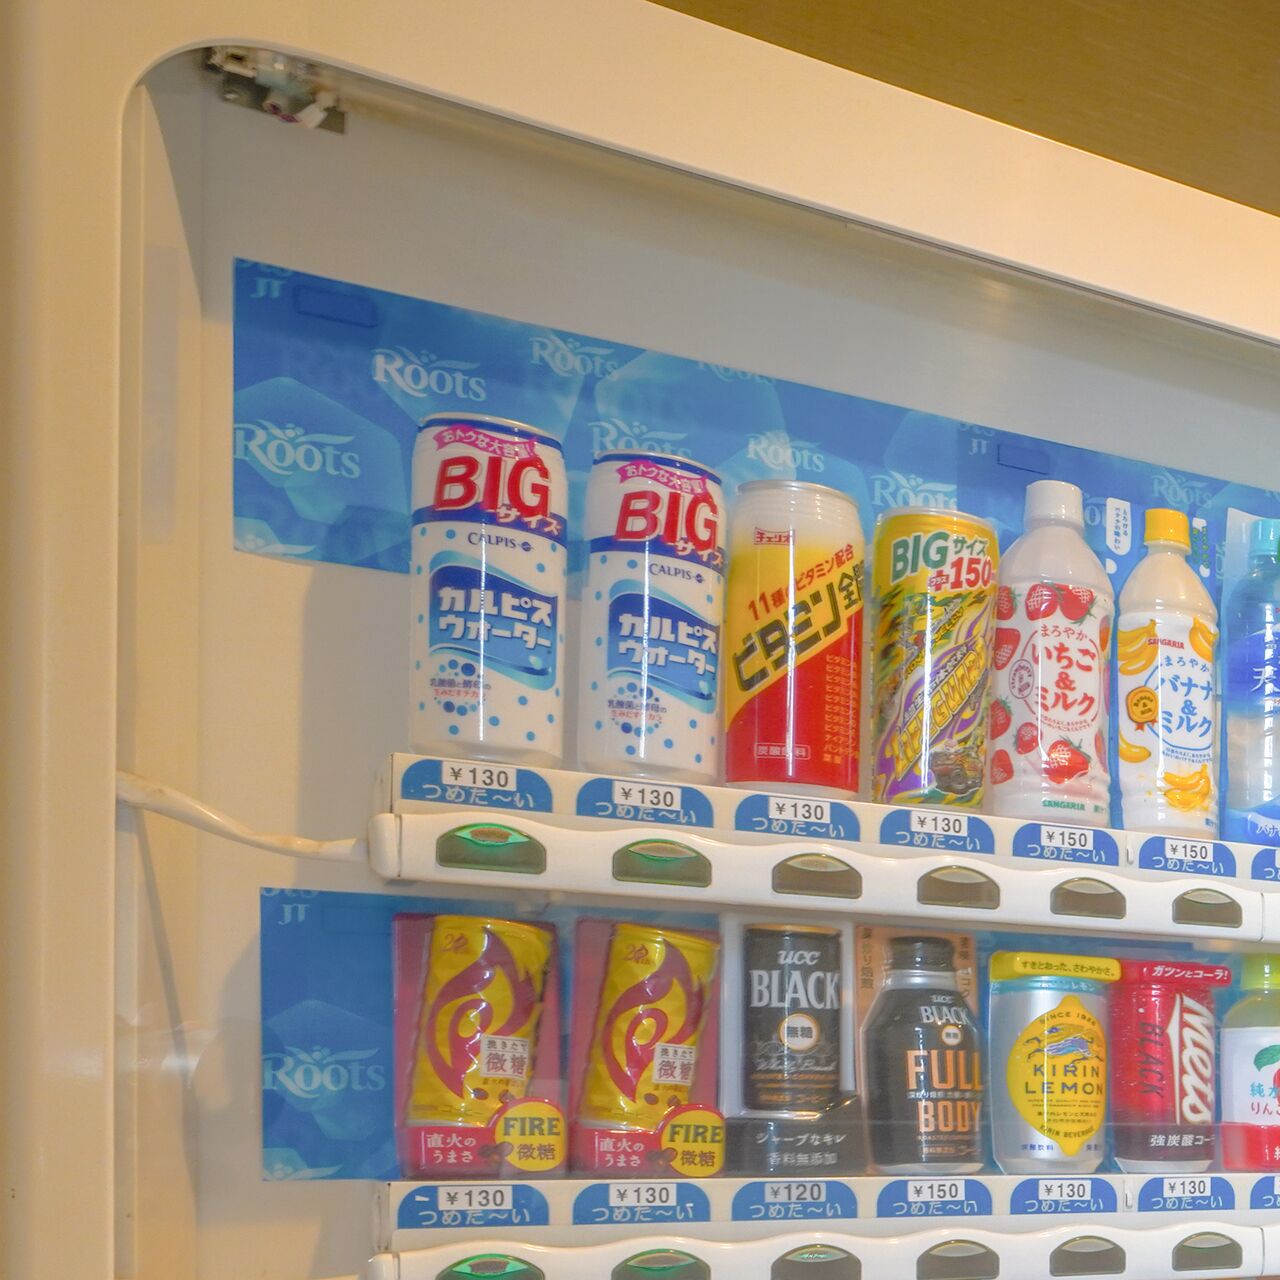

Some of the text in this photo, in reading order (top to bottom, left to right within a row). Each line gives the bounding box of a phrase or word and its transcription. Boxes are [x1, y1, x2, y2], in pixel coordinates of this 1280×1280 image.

[373, 346, 487, 402] Roots
[234, 419, 360, 480] Roots
[434, 456, 550, 518] BIG
[496, 503, 562, 536] サイズ
[614, 490, 718, 550] BIG
[468, 532, 517, 549] CALPIS
[676, 537, 725, 566] サイズ
[891, 532, 988, 582] BIG サイズ
[649, 562, 692, 580] CALPIS
[438, 587, 553, 628] カルピス
[618, 612, 718, 655] カルピス
[1041, 624, 1088, 641] まろやか
[1031, 642, 1097, 673] いちご
[1164, 655, 1210, 673] まろやか
[1055, 671, 1077, 692] &
[1155, 673, 1213, 701] バナナ
[1034, 686, 1095, 716] ミルク
[1180, 699, 1198, 717] &
[1160, 710, 1213, 738] ミルク
[449, 765, 510, 788] ¥130
[620, 786, 675, 807] ¥130
[774, 802, 824, 821] ¥130
[917, 816, 963, 834] ¥130
[1045, 830, 1088, 848] ¥150
[1169, 844, 1209, 860] ¥150
[749, 969, 840, 1010] BLACK
[920, 1005, 969, 1025] BLACK
[485, 1052, 527, 1074] 微糖
[906, 1049, 983, 1091] FULL
[1032, 1064, 1100, 1077] KIRIN
[1137, 1021, 1165, 1099] BLACK
[262, 1045, 386, 1100] Roots
[1025, 1081, 1103, 1095] LEMON
[503, 1116, 561, 1137] FIRE
[917, 1101, 982, 1132] BODY
[425, 1132, 476, 1150] 直火の
[668, 1123, 724, 1144] FIRE
[516, 1143, 556, 1161] 微糖
[599, 1138, 644, 1152] 直火の
[433, 1149, 474, 1166] うまさ
[603, 1153, 641, 1167] うまさ
[681, 1149, 715, 1167] 微糖
[446, 1188, 505, 1207] ¥130
[616, 1187, 671, 1204] ¥130
[770, 1183, 822, 1201] ¥120
[913, 1184, 959, 1200] ¥150
[1044, 1183, 1087, 1199] ¥130
